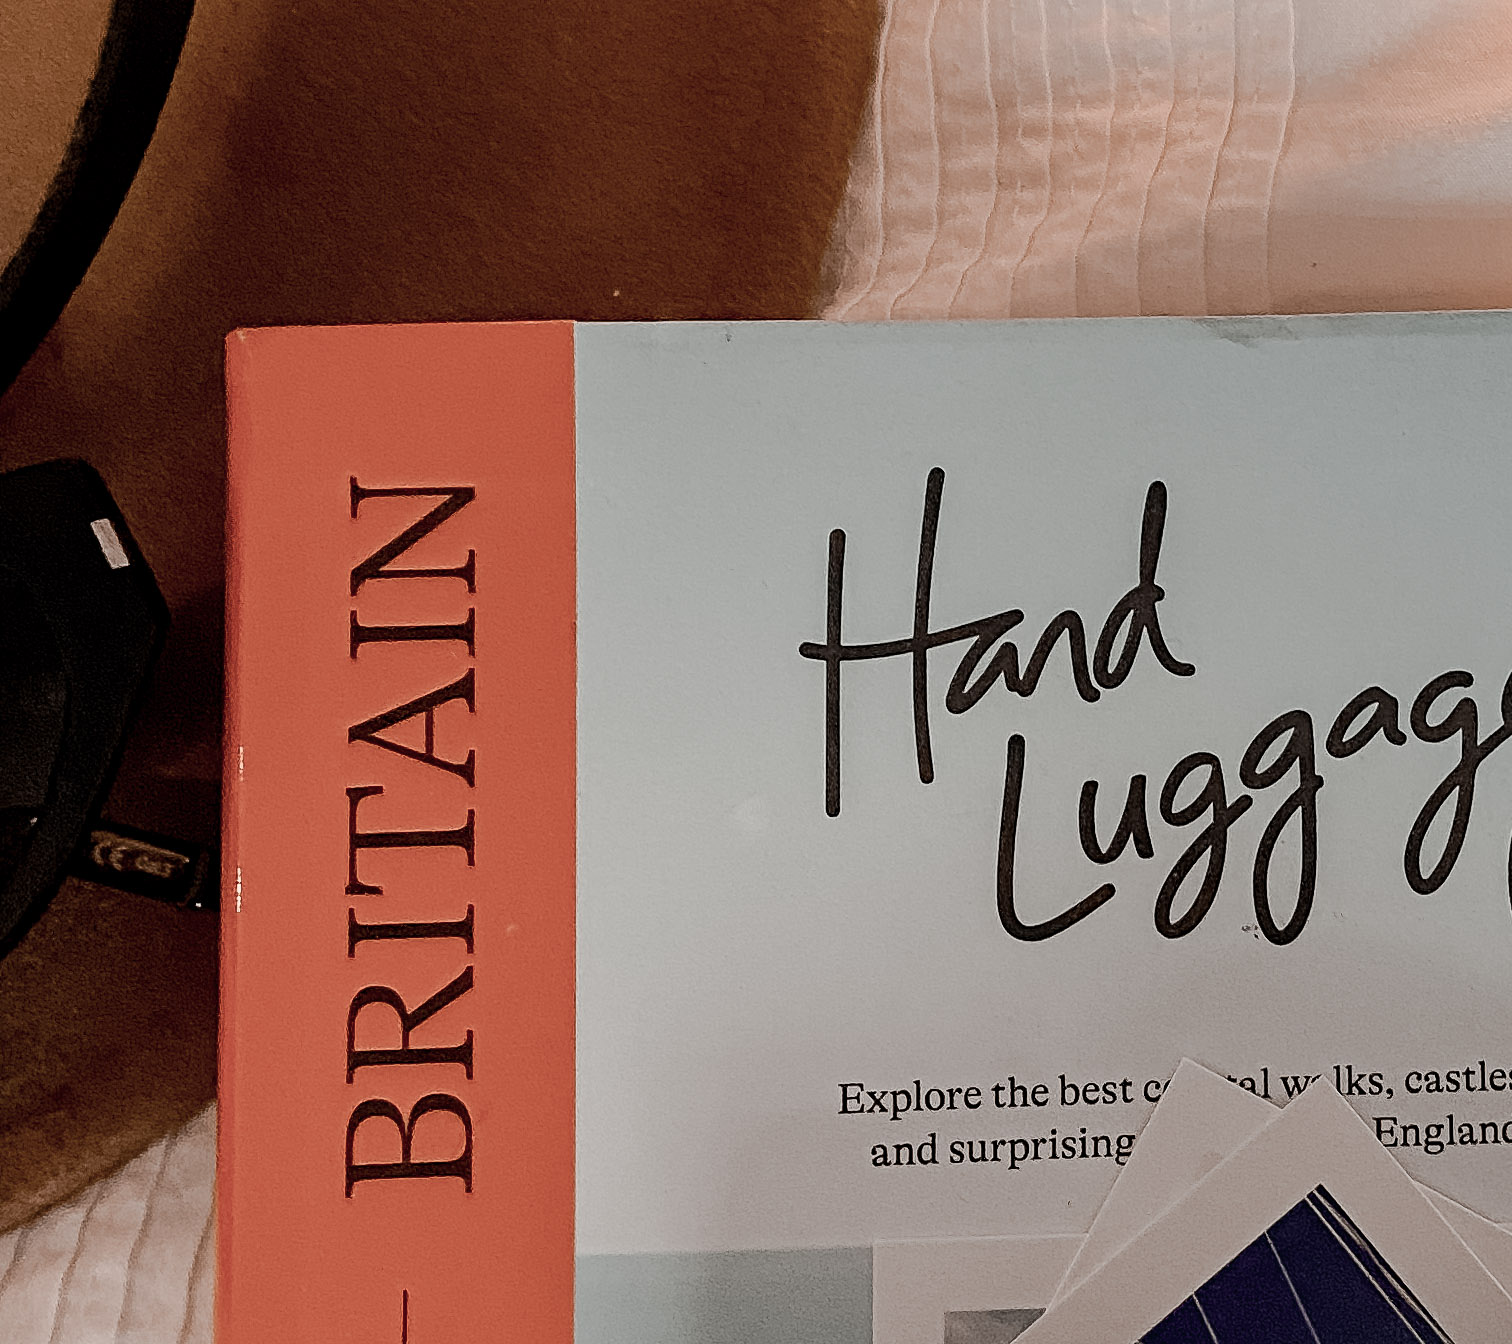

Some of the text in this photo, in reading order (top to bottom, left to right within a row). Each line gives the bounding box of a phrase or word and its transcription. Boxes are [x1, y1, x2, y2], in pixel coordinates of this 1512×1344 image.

[799, 467, 1196, 817] Hand
[344, 474, 477, 1200] BRITAIN
[837, 1079, 982, 1122] Explore
[990, 1075, 1050, 1109] the
[1057, 1073, 1135, 1106] best
[1279, 1064, 1394, 1100] wlks,
[870, 1132, 940, 1167] and
[949, 1127, 1136, 1171] surprising
